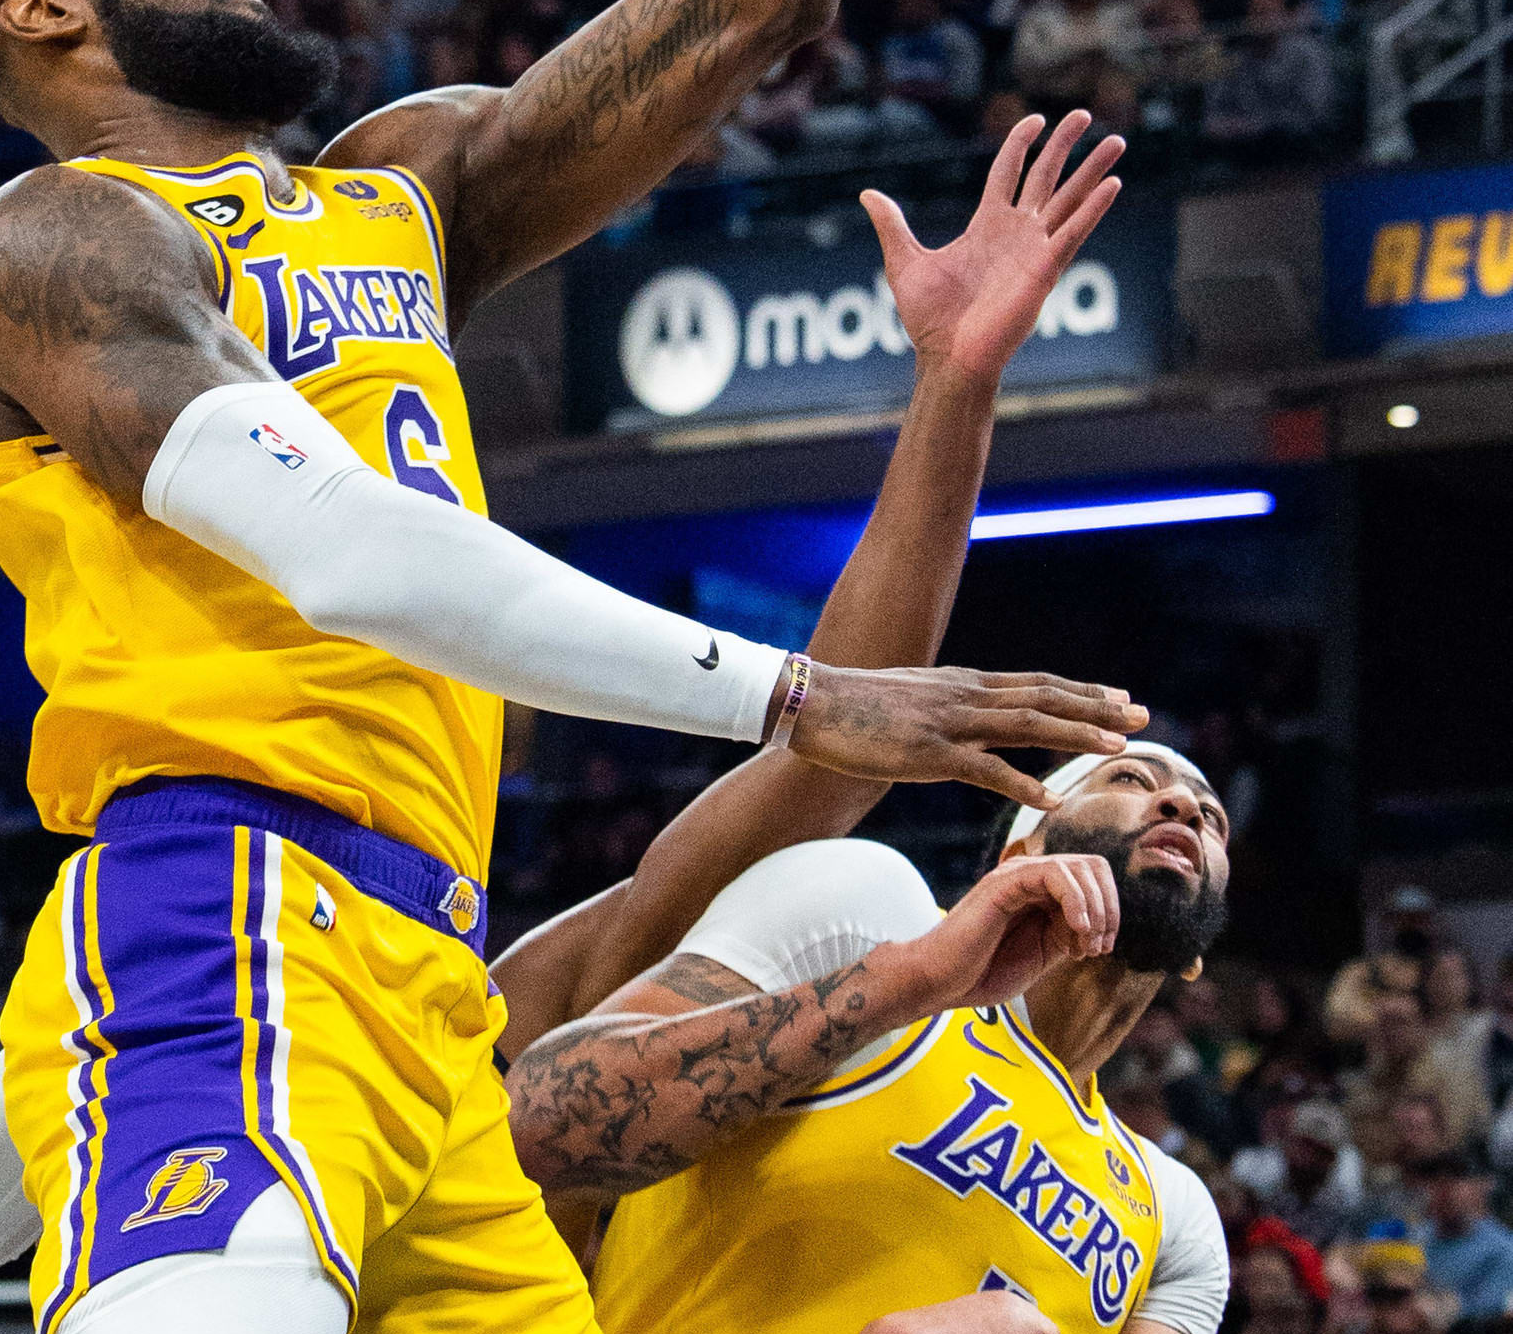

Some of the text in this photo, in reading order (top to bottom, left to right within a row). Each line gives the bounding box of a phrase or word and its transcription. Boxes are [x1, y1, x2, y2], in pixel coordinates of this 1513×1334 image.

[192, 200, 238, 226] 6
[242, 253, 455, 381] LAKERS
[745, 261, 1119, 370] mota
[888, 1071, 1145, 1328] LAKERS
